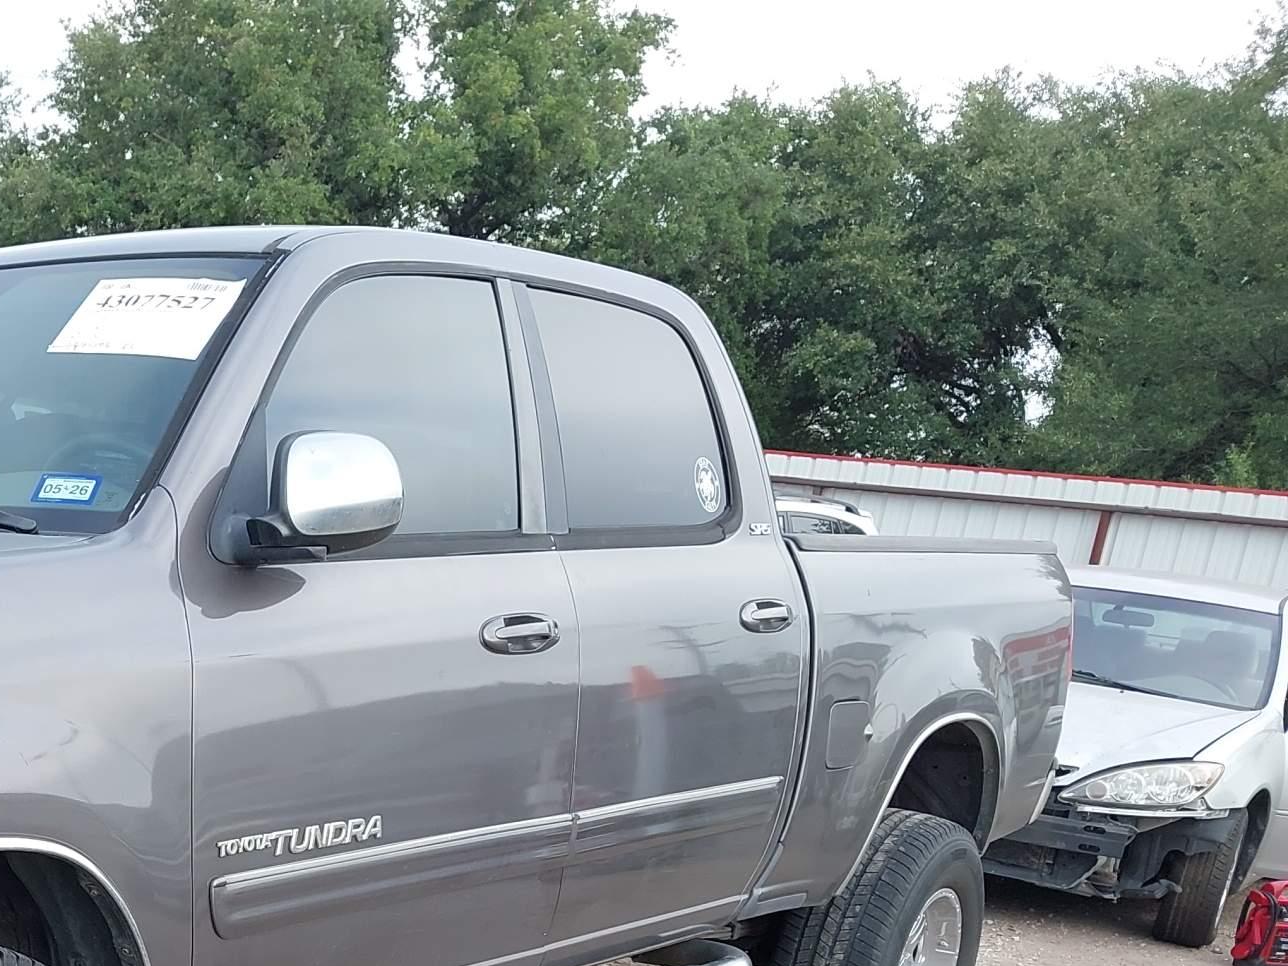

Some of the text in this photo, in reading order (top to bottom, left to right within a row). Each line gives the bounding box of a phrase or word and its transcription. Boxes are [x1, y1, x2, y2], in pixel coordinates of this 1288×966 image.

[96, 294, 216, 310] 43077527
[215, 815, 383, 857] TOYOTA TUNDRA
